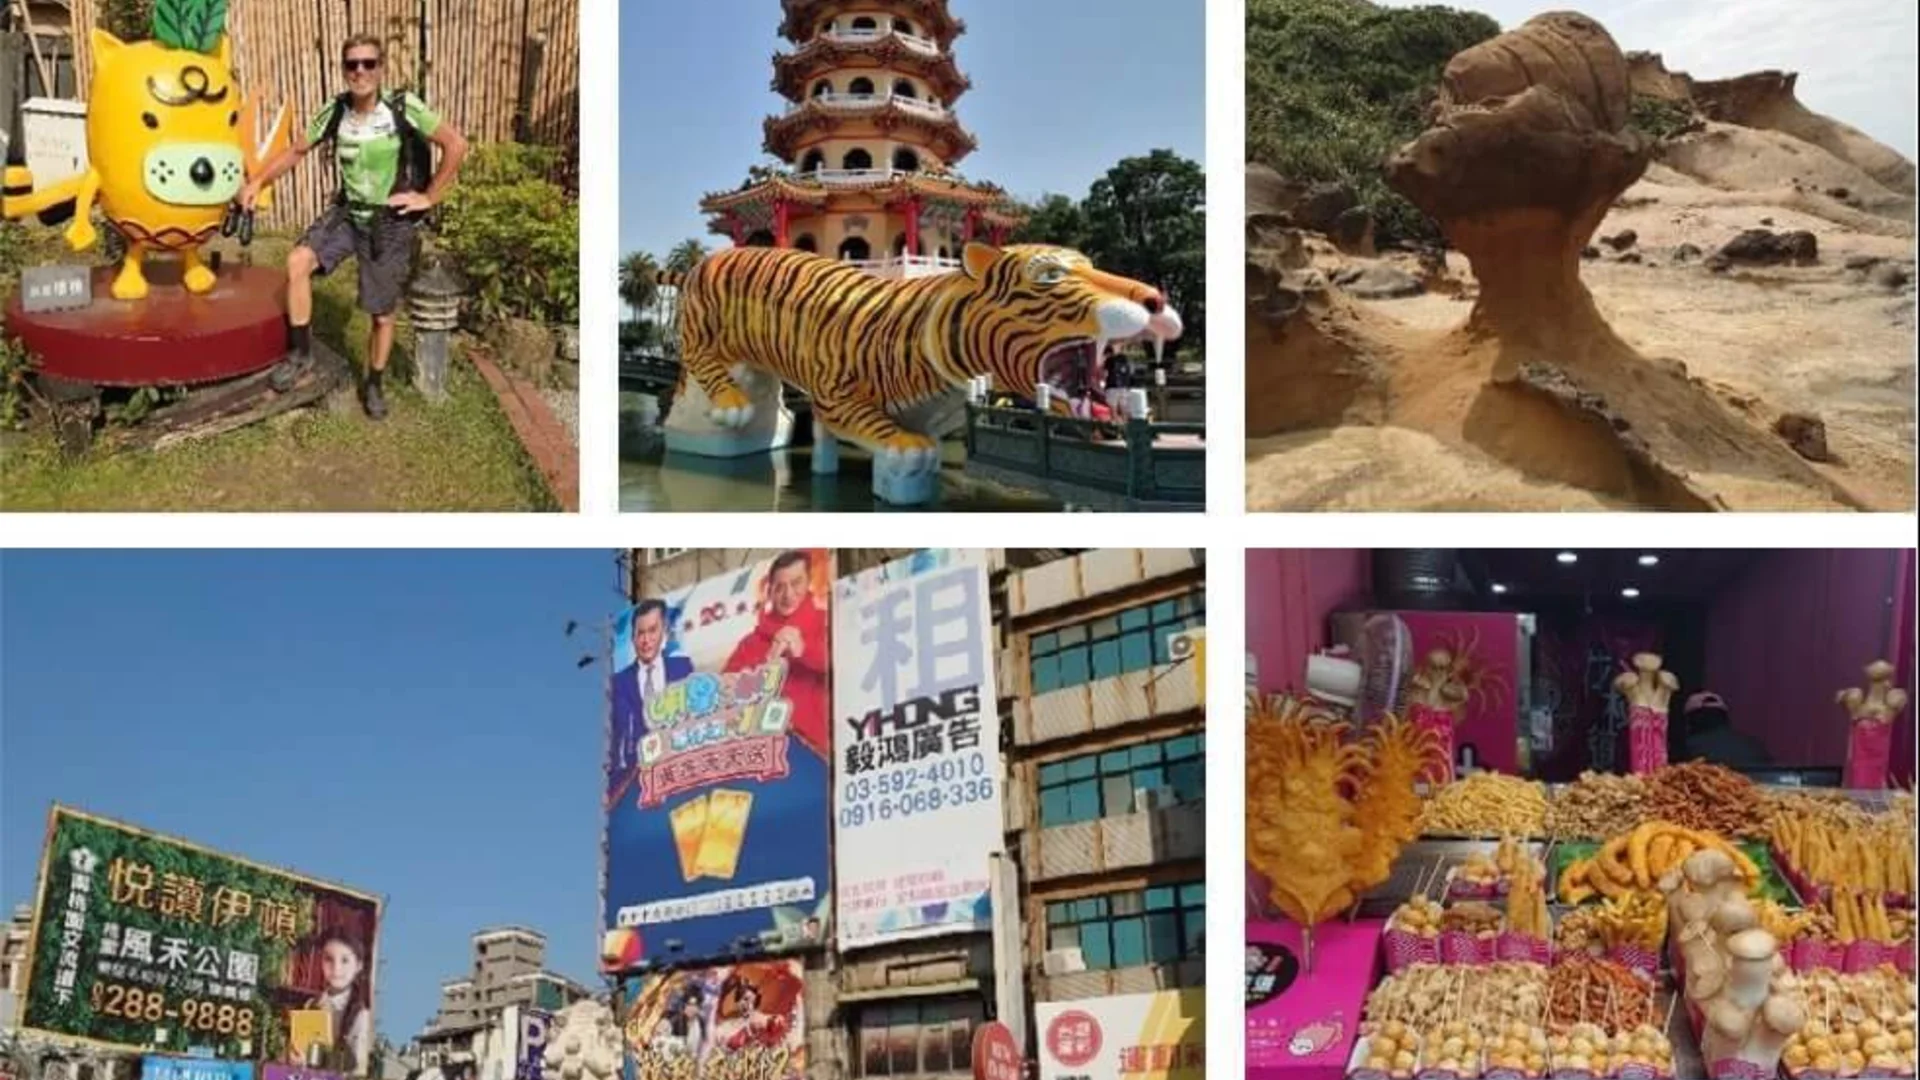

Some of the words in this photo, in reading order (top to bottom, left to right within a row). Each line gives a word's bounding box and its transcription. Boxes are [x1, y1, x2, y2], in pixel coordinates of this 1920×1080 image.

[861, 564, 984, 712] 租
[845, 717, 982, 764] 毅鴻廣告
[848, 685, 980, 741] YHONG
[119, 927, 260, 985] 風禾公園
[104, 984, 255, 1037] 288-9888
